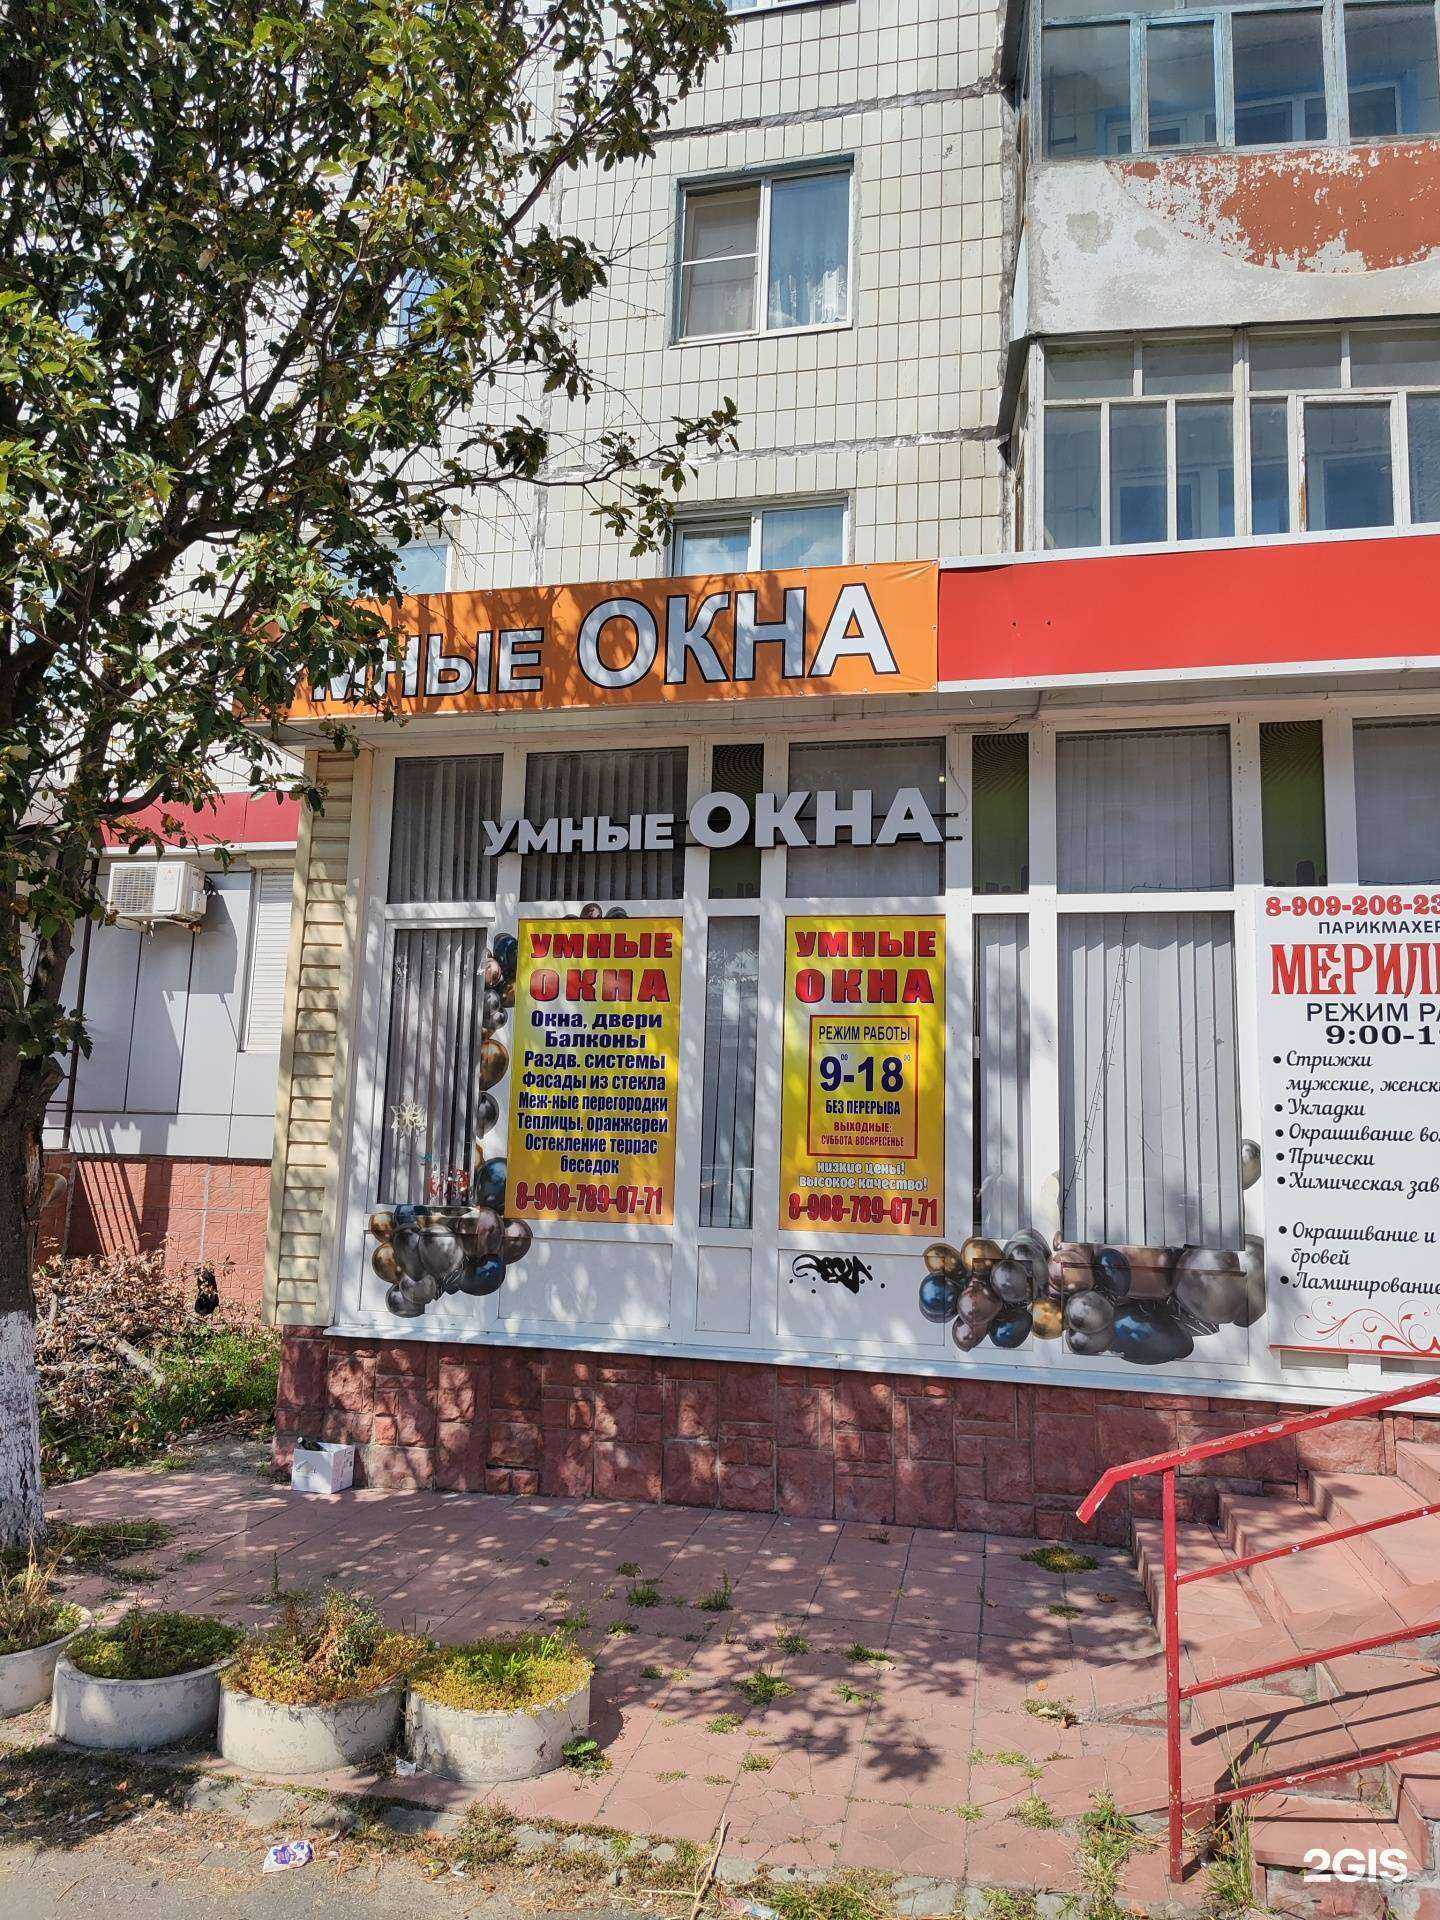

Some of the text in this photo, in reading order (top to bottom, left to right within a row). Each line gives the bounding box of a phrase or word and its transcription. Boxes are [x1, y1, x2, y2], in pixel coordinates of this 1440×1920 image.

[577, 582, 900, 690] ОКНА
[481, 786, 945, 857] УМНЫЕ ОКНА
[530, 932, 673, 959] УМНЫЕ
[795, 930, 936, 958] УМНЫЕ
[1269, 943, 1440, 999] МЕРИЛ
[529, 968, 671, 1003] ОКНА
[795, 968, 935, 1004] ОКНА
[531, 1010, 662, 1030] Окна, двери
[1306, 1002, 1408, 1022] РЕЖИМ
[545, 1030, 646, 1049] Балконы
[818, 1026, 910, 1041] РЕЖИМ РАБОТЫ
[1325, 1025, 1440, 1045] 9:00-1
[524, 1051, 666, 1070] Раздв. системы
[1286, 1050, 1374, 1073] Стрижки
[522, 1071, 666, 1091] Фасады из стекла
[1286, 1079, 1440, 1098] мужские, женск
[518, 1092, 668, 1113] Меж-ные перегородки
[825, 1100, 901, 1115] БЕЗ ПЕРЕРЫВА
[1288, 1098, 1366, 1123] Укладки
[517, 1112, 583, 1132] Теплицы,
[833, 1121, 892, 1133] ВЫХОДНЫЕ:
[525, 1133, 658, 1155] Остекление террас
[855, 1136, 905, 1147] ВОСКРЕСЕНЬЕ
[1289, 1123, 1415, 1147] Окрашивание
[560, 1155, 620, 1175] беседок
[1289, 1148, 1375, 1171] Прически
[1288, 1171, 1404, 1192] Химическая
[515, 1181, 663, 1215] 8-908-789-07-71
[788, 1192, 938, 1227] 8-908-789-07-71
[1293, 1222, 1437, 1246] Окрашивание и
[1290, 1248, 1351, 1270] бровей
